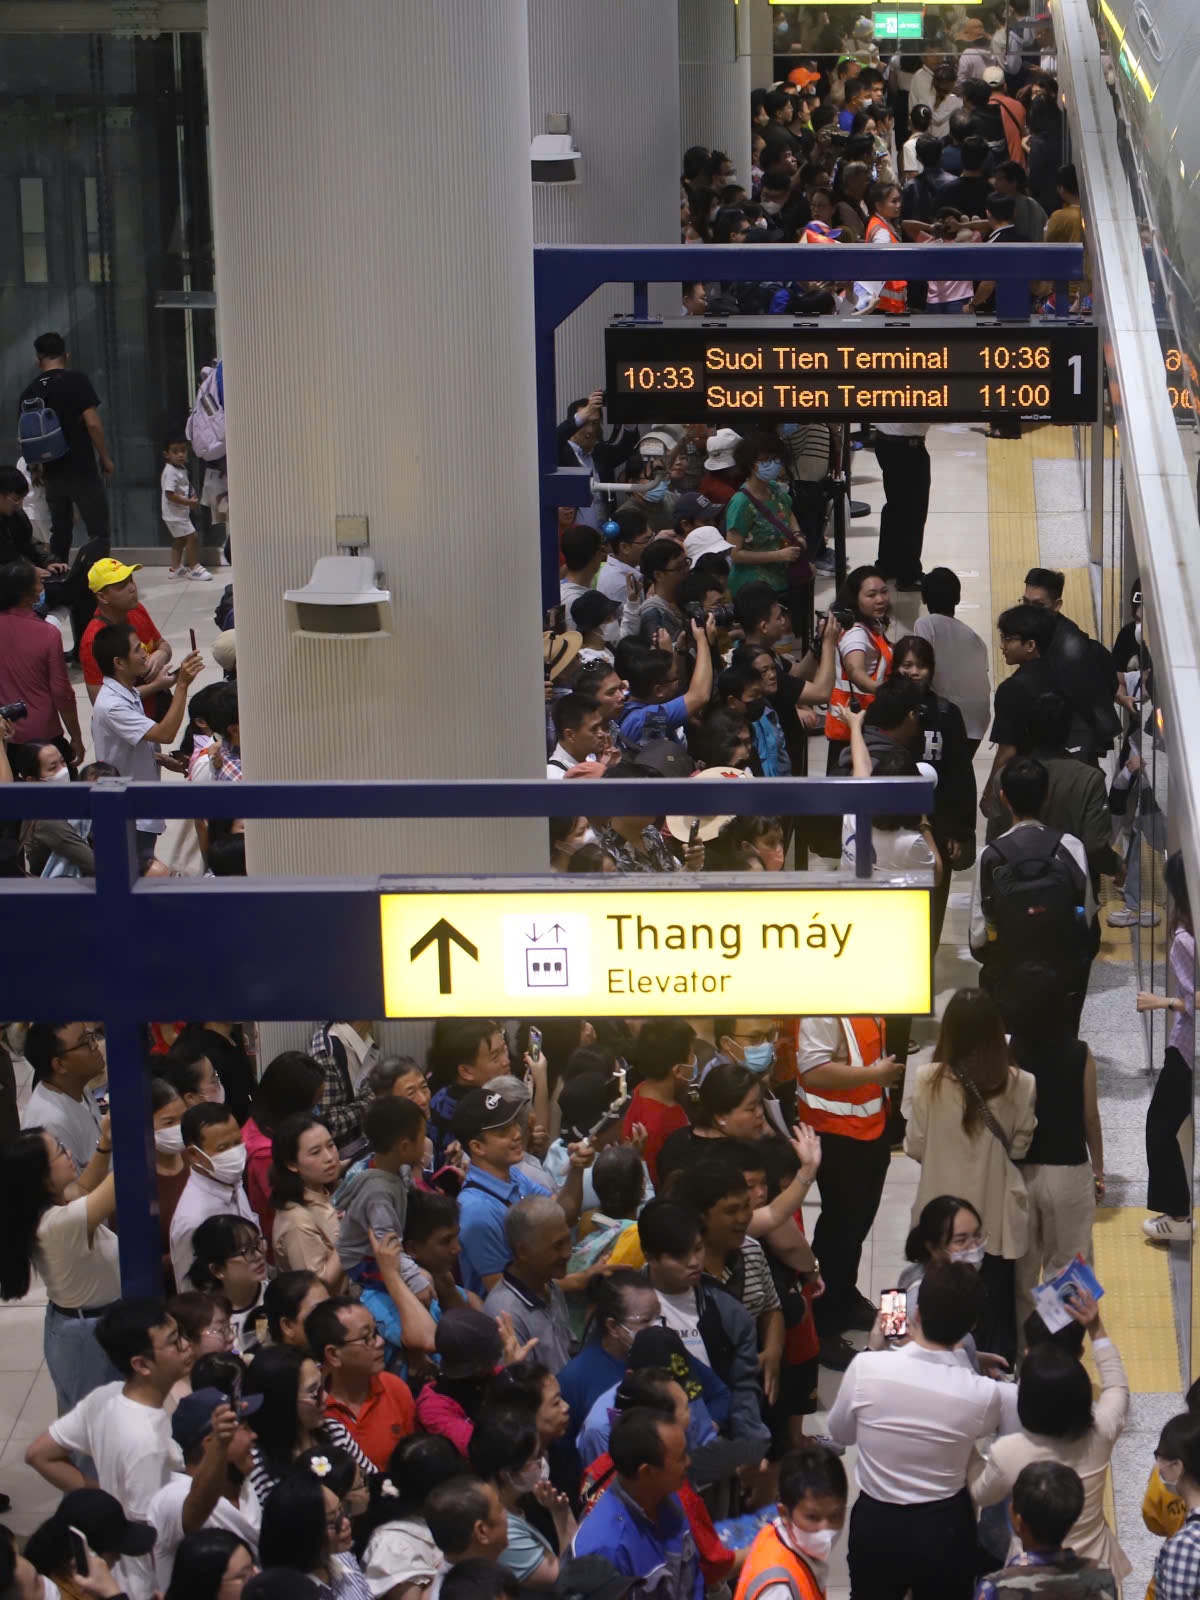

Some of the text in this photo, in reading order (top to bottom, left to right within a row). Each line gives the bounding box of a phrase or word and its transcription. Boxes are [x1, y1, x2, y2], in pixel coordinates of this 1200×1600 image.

[705, 346, 1050, 370] Suoi Tien Terminal 10:36
[623, 366, 695, 390] 10:33
[1068, 355, 1082, 395] 1
[706, 384, 1050, 408] Suoi Tien Terminal 11:00
[606, 912, 853, 960] Thang máy
[608, 968, 732, 994] Elevator
